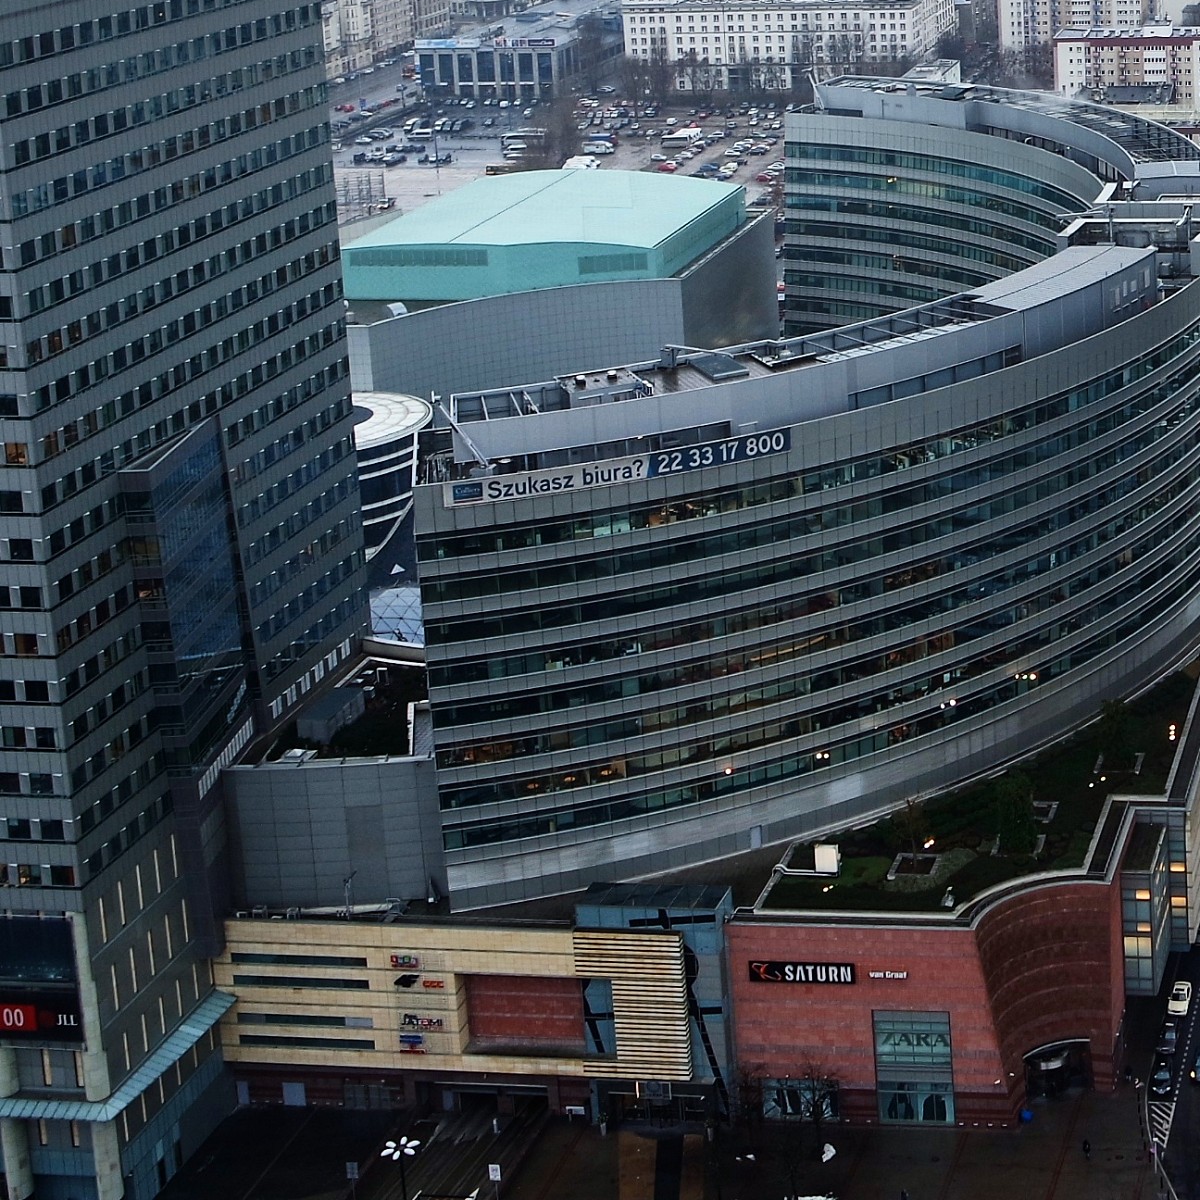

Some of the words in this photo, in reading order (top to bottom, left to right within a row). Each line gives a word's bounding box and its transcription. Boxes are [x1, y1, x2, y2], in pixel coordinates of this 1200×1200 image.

[487, 475, 575, 499] Szukasz
[582, 459, 644, 486] biura?
[657, 452, 683, 473] 22
[689, 446, 714, 467] 33
[719, 440, 739, 462] 17
[745, 432, 785, 456] 800
[784, 964, 852, 983] SATURN
[57, 1014, 78, 1026] JLL
[881, 1032, 950, 1047] ZARA
